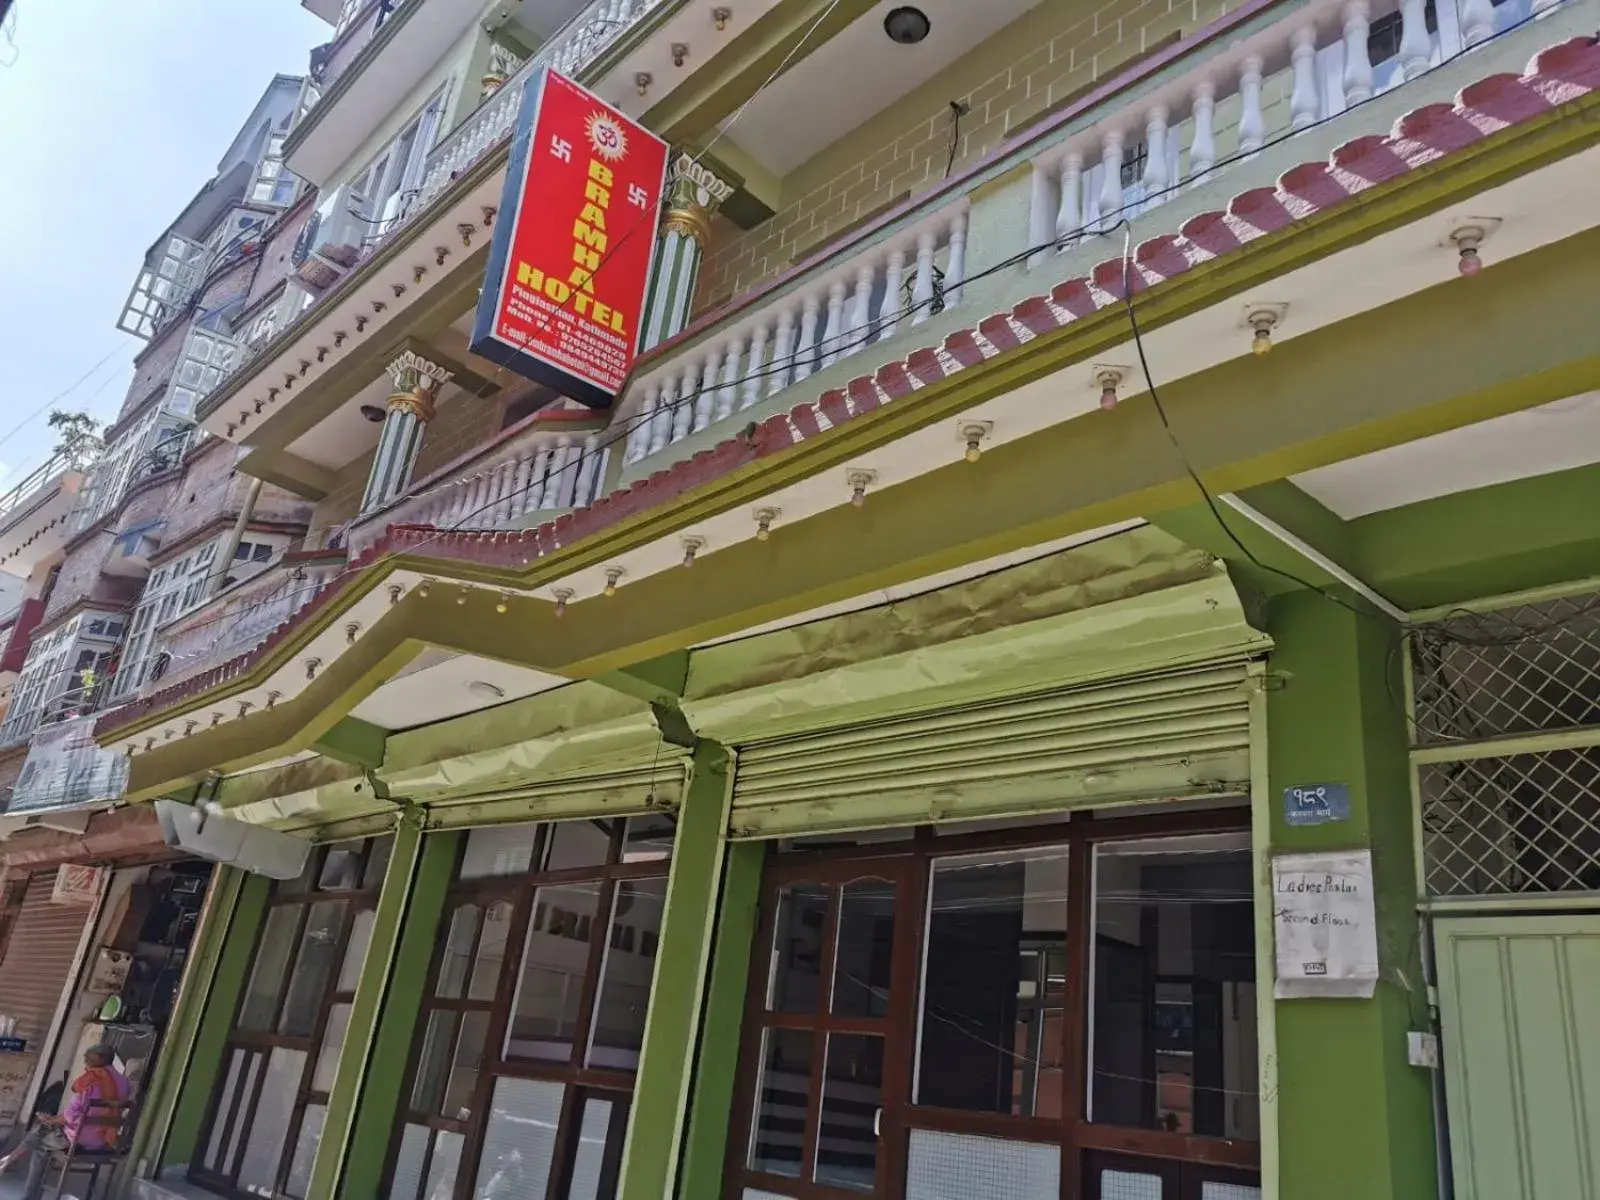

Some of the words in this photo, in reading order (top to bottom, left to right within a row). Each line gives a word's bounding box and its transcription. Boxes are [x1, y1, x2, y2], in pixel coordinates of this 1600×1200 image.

[567, 157, 614, 294] BRAMHA
[510, 297, 549, 321] Phone
[516, 261, 628, 337] HOTEL
